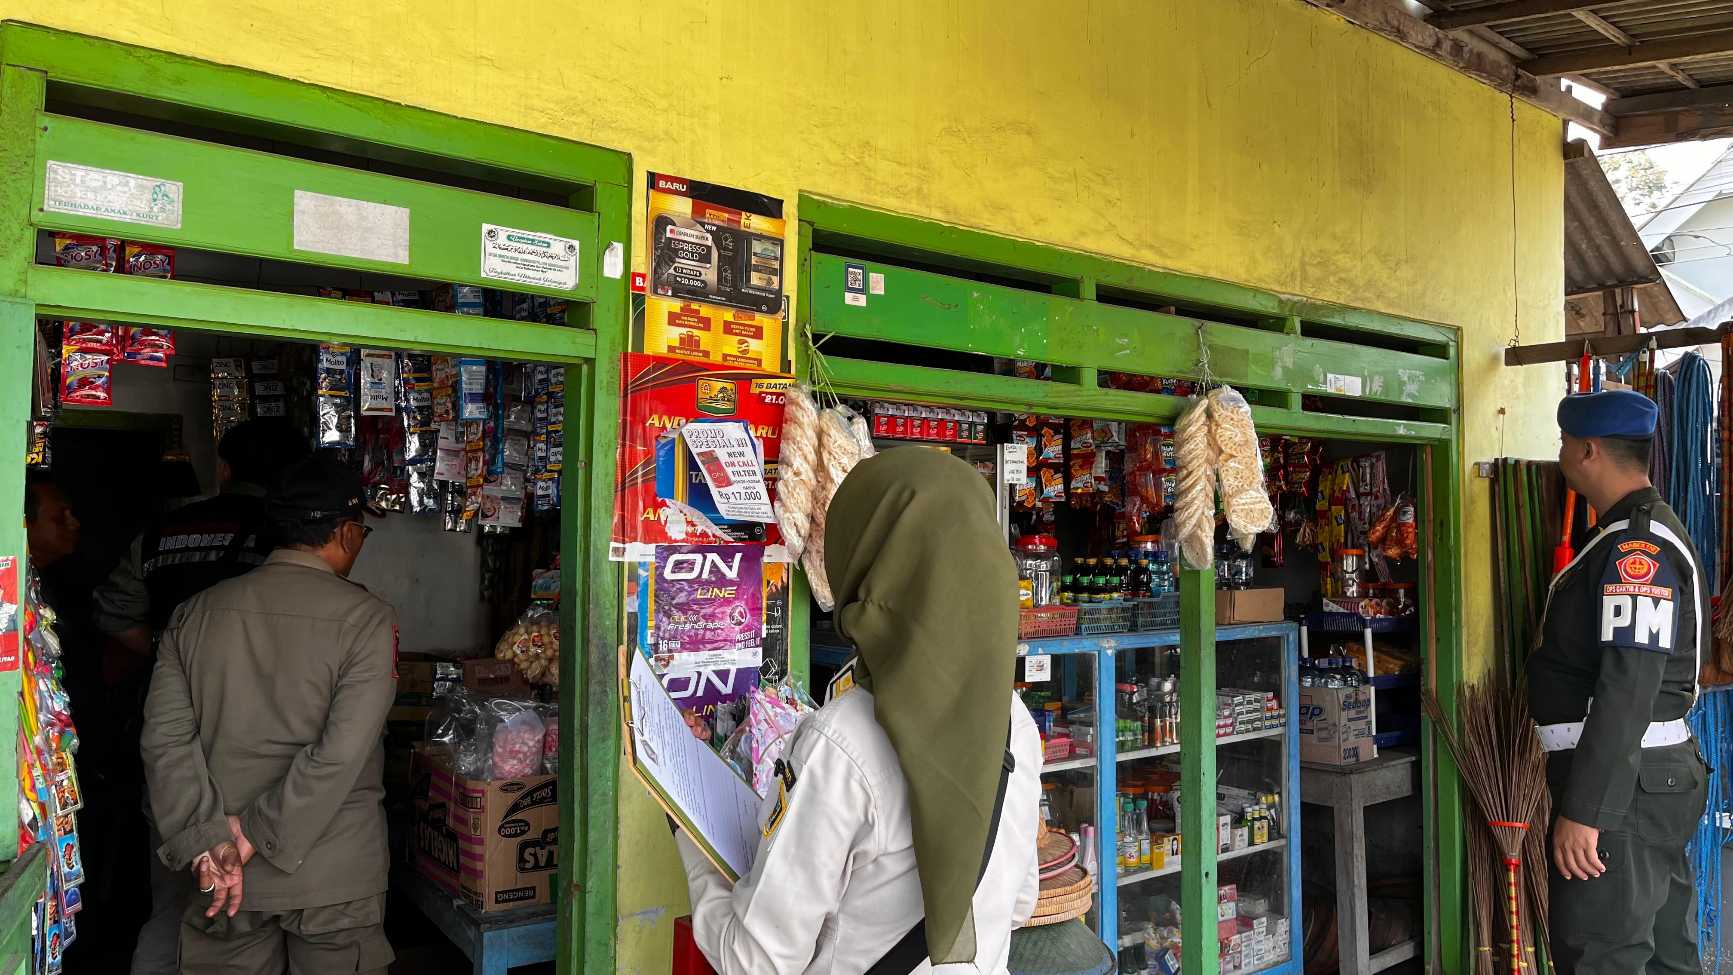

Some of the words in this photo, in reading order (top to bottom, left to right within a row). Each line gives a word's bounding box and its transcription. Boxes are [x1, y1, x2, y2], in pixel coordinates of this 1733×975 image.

[659, 180, 687, 192] BARU
[704, 224, 717, 232] NEW
[671, 240, 707, 254] ESPRESSO
[678, 251, 699, 260] GOLD
[325, 357, 345, 366] Molto
[646, 414, 686, 429] AND
[748, 423, 779, 438] ARU
[687, 428, 726, 439] PROMO
[725, 460, 736, 468] ON
[736, 460, 756, 468] CALL
[690, 471, 708, 484] TA
[731, 469, 757, 478] FILTER
[718, 490, 731, 502] Rp
[732, 490, 762, 501] 17.000
[663, 552, 743, 580] ON
[696, 586, 738, 599] LINE
[1606, 584, 1616, 593] OPS
[1639, 586, 1650, 594] OPS
[1601, 594, 1674, 649] PM
[735, 631, 751, 641] PRESS
[659, 639, 668, 651] 16
[661, 666, 738, 699] ON
[692, 703, 718, 717] LIN
